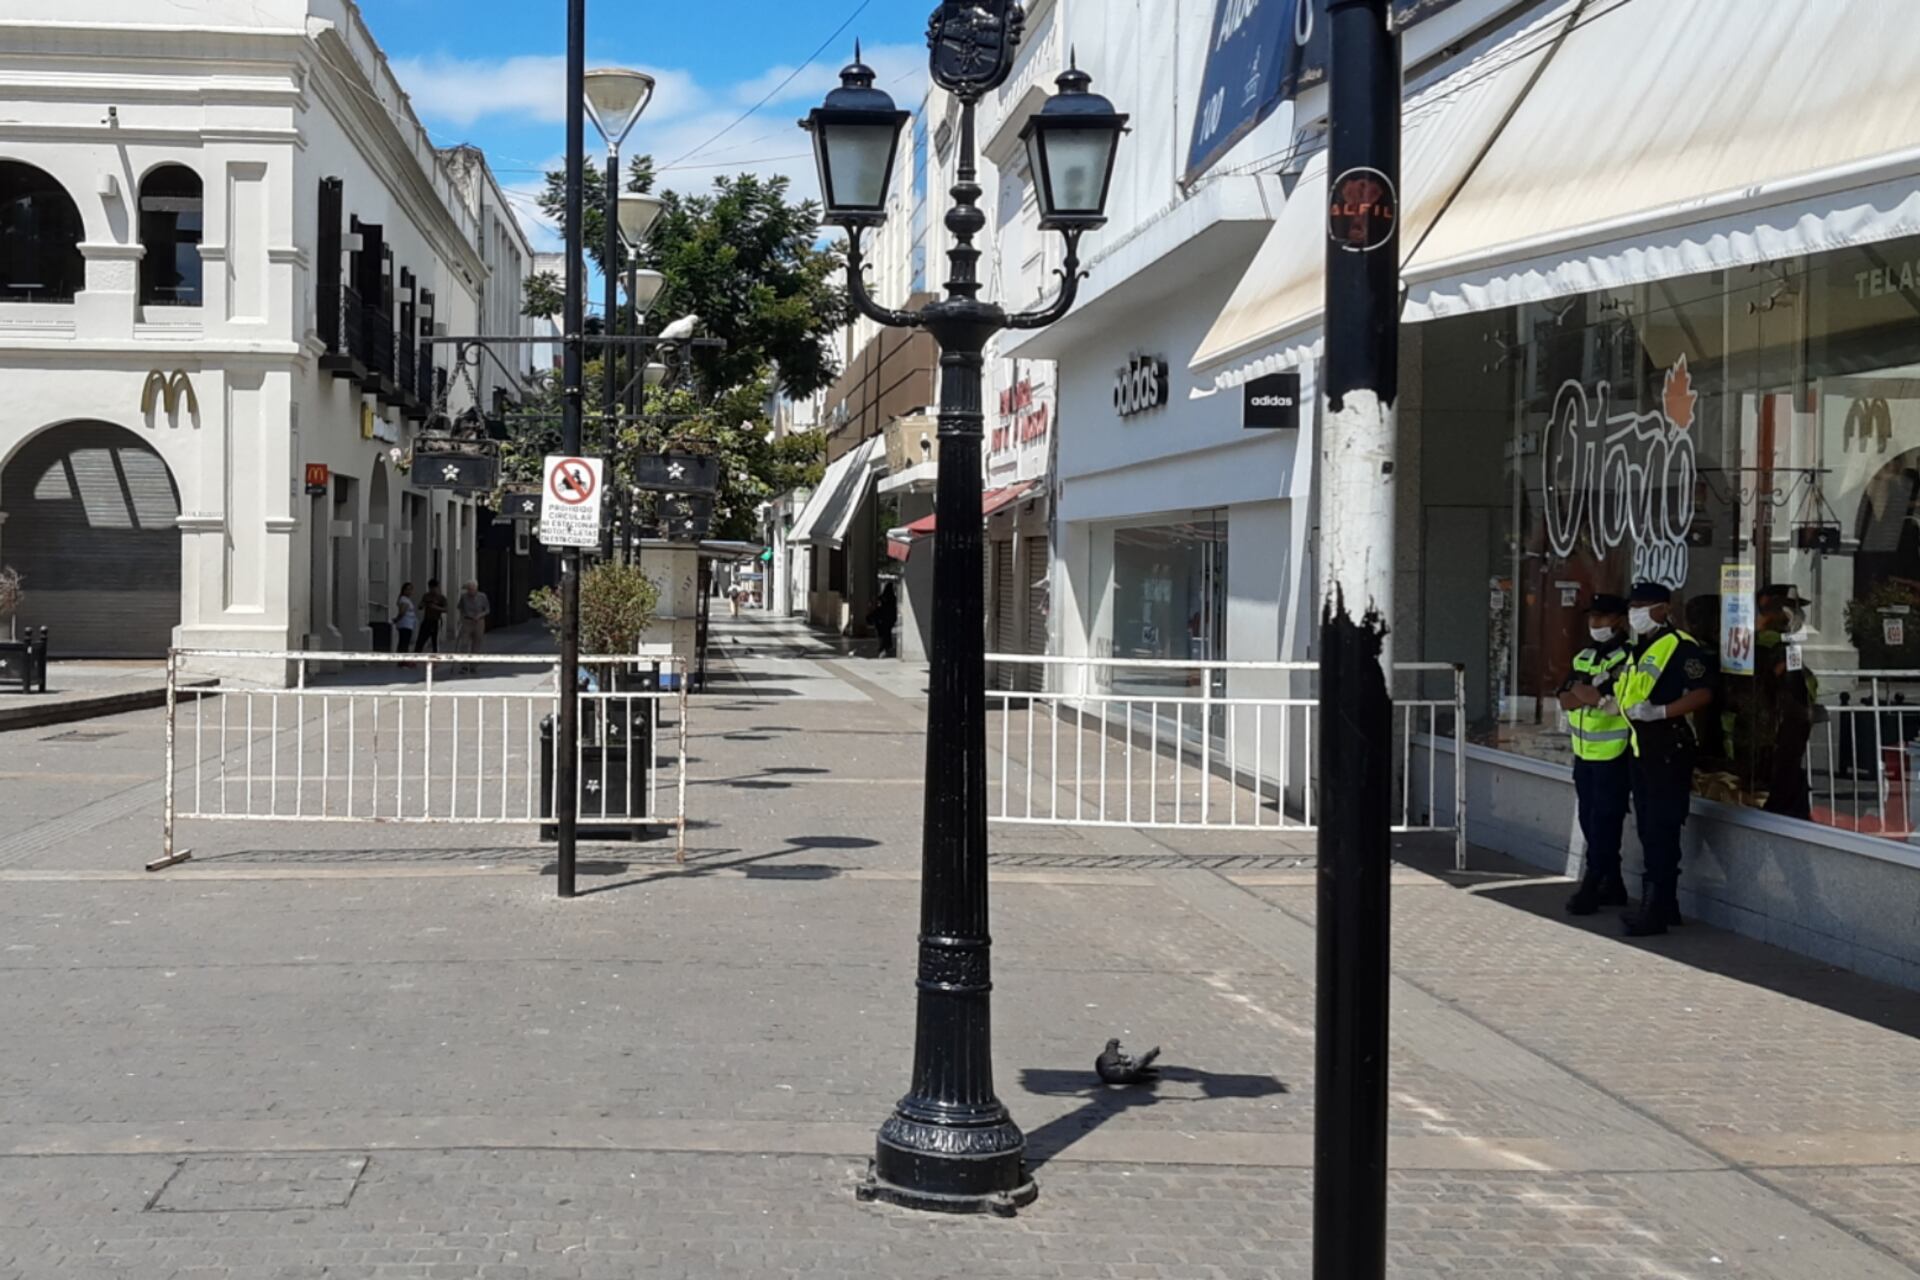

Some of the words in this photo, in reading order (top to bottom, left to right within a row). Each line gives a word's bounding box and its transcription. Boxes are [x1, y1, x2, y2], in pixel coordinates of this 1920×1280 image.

[1331, 203, 1393, 218] ALFIL
[1113, 355, 1161, 416] adidas
[1251, 395, 1293, 407] adidas
[548, 512, 592, 520] CIRCULAR
